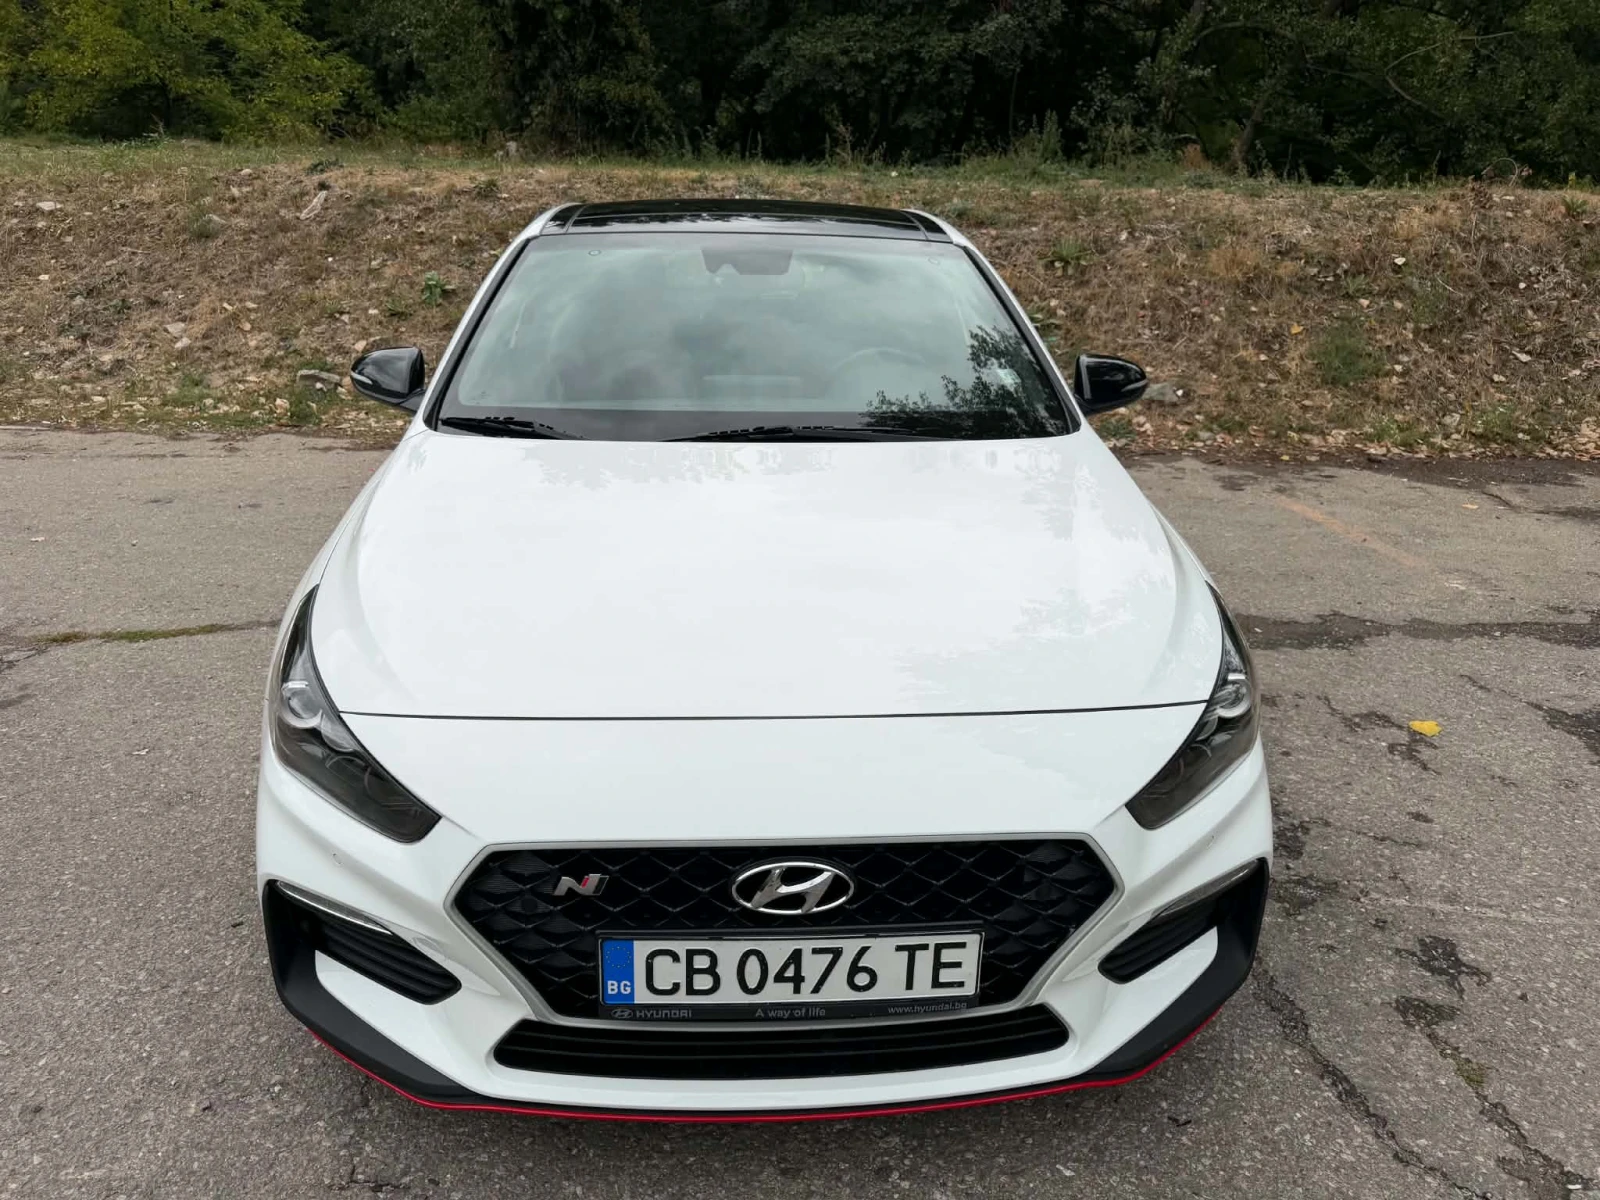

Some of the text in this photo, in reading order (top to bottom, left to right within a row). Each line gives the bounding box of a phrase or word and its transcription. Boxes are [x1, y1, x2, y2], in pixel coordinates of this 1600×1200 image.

[645, 941, 968, 996] CB 0476 TE
[607, 980, 632, 995] BG
[636, 1010, 692, 1019] HYUNDAI
[755, 1007, 826, 1019] A way of life
[887, 1001, 968, 1015] www.hyundai.bg
